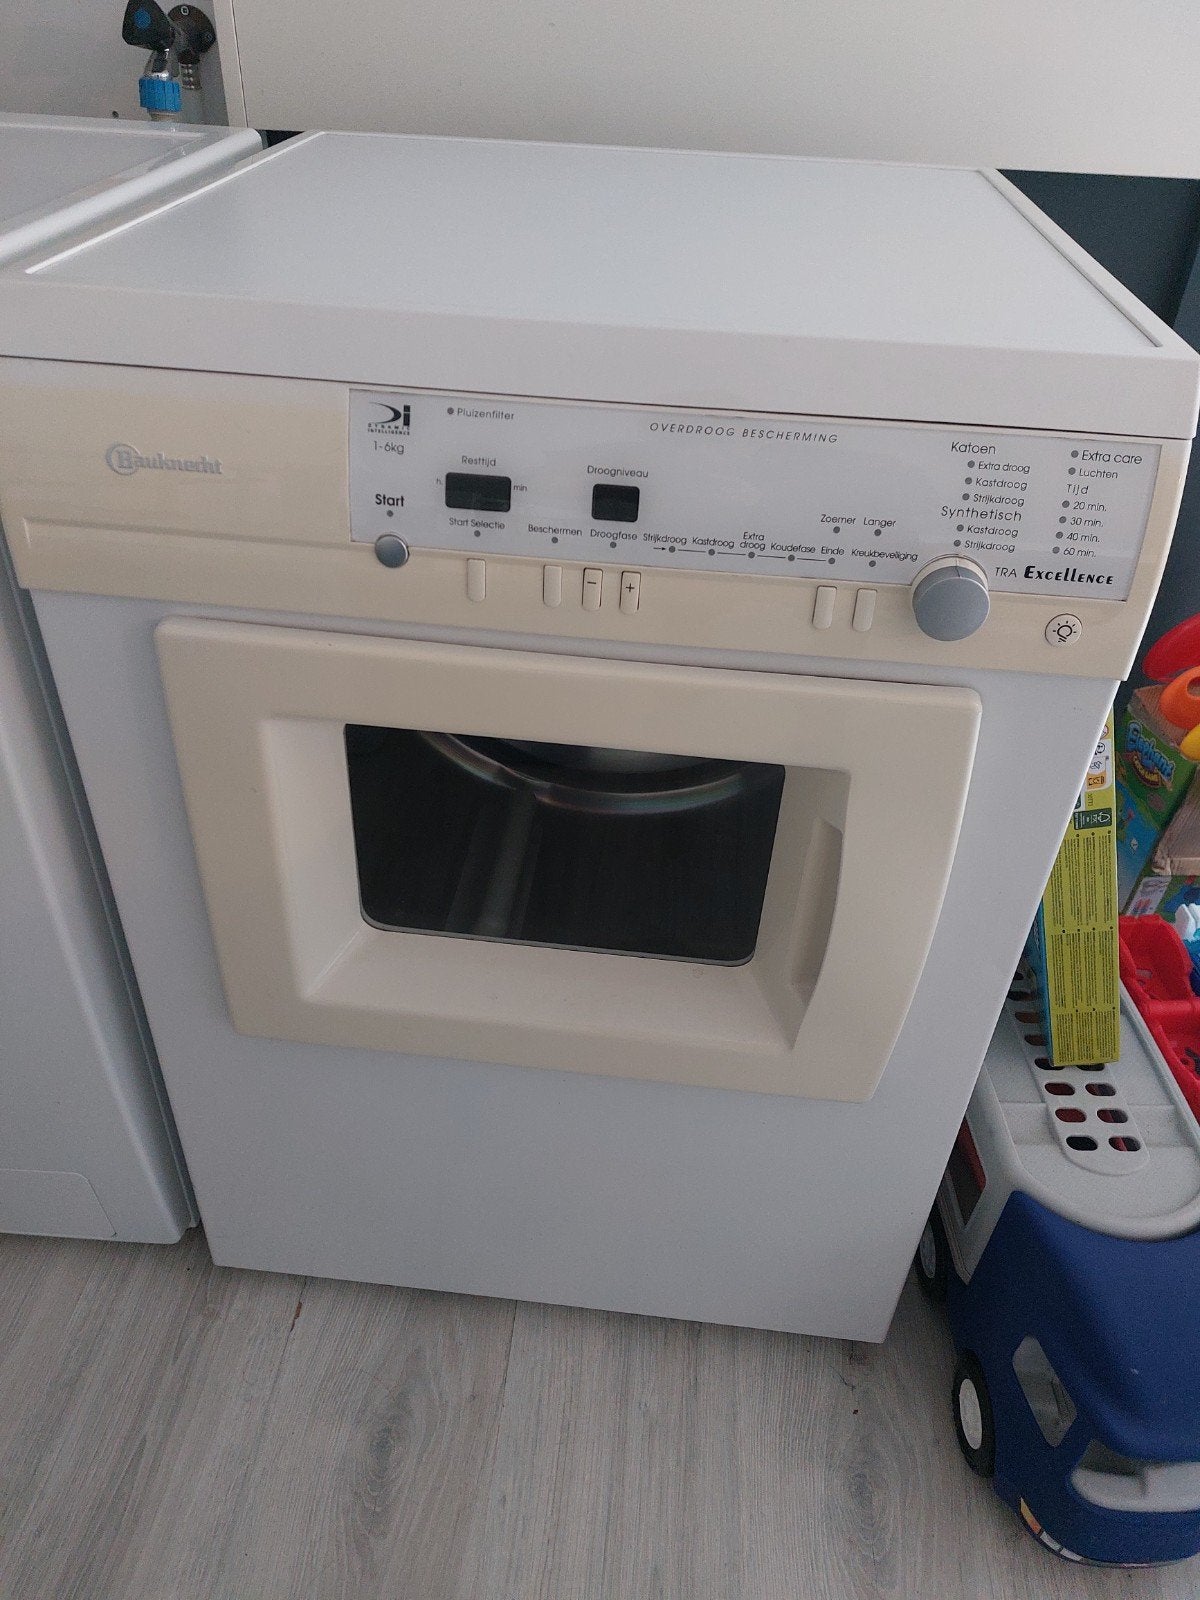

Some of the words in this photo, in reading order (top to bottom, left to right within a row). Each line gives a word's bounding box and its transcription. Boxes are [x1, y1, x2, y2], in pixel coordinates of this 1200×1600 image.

[457, 407, 515, 420] Pluizenfilter
[650, 422, 735, 437] OVERDROOG
[742, 428, 839, 444] BESCHERMING
[951, 441, 996, 455] Katoen
[461, 455, 497, 468] Resttijd
[1082, 449, 1111, 463] Extra
[1113, 454, 1143, 465] care
[587, 465, 649, 479] Droogniveau
[978, 461, 1001, 471] Extra
[1003, 463, 1030, 474] droog
[1079, 468, 1118, 479] Luchten
[513, 484, 528, 492] min
[975, 477, 1028, 491] Kastdroog
[1067, 483, 1089, 496] Tijd
[375, 494, 405, 507] Start
[973, 493, 1025, 507] Strijkdroog
[1073, 501, 1086, 510] 20
[1088, 503, 1107, 512] min.
[820, 514, 856, 525] Zoemer
[941, 506, 1022, 522] Synthetisch
[449, 517, 469, 527] Start
[470, 519, 505, 530] Selectie
[863, 517, 896, 528] Langer
[1070, 517, 1083, 526] 30
[1084, 519, 1104, 528] min.
[528, 524, 583, 537] Beschermen
[590, 529, 638, 541] Droogfase
[743, 532, 765, 541] Extra
[967, 525, 1019, 538] Kastdroog
[643, 533, 688, 545] Strijkdroog
[692, 537, 735, 549] Kastdroog
[1066, 532, 1079, 541] 40
[1081, 534, 1100, 543] min.
[739, 540, 766, 552] droog
[770, 543, 816, 554] Koudefase
[821, 545, 845, 556] Einde
[964, 540, 1016, 553] Strijkdroog
[1063, 547, 1075, 556] 60
[1077, 548, 1096, 558] min.
[851, 548, 919, 563] Kreukbeveiliging
[995, 567, 1017, 578] TRA
